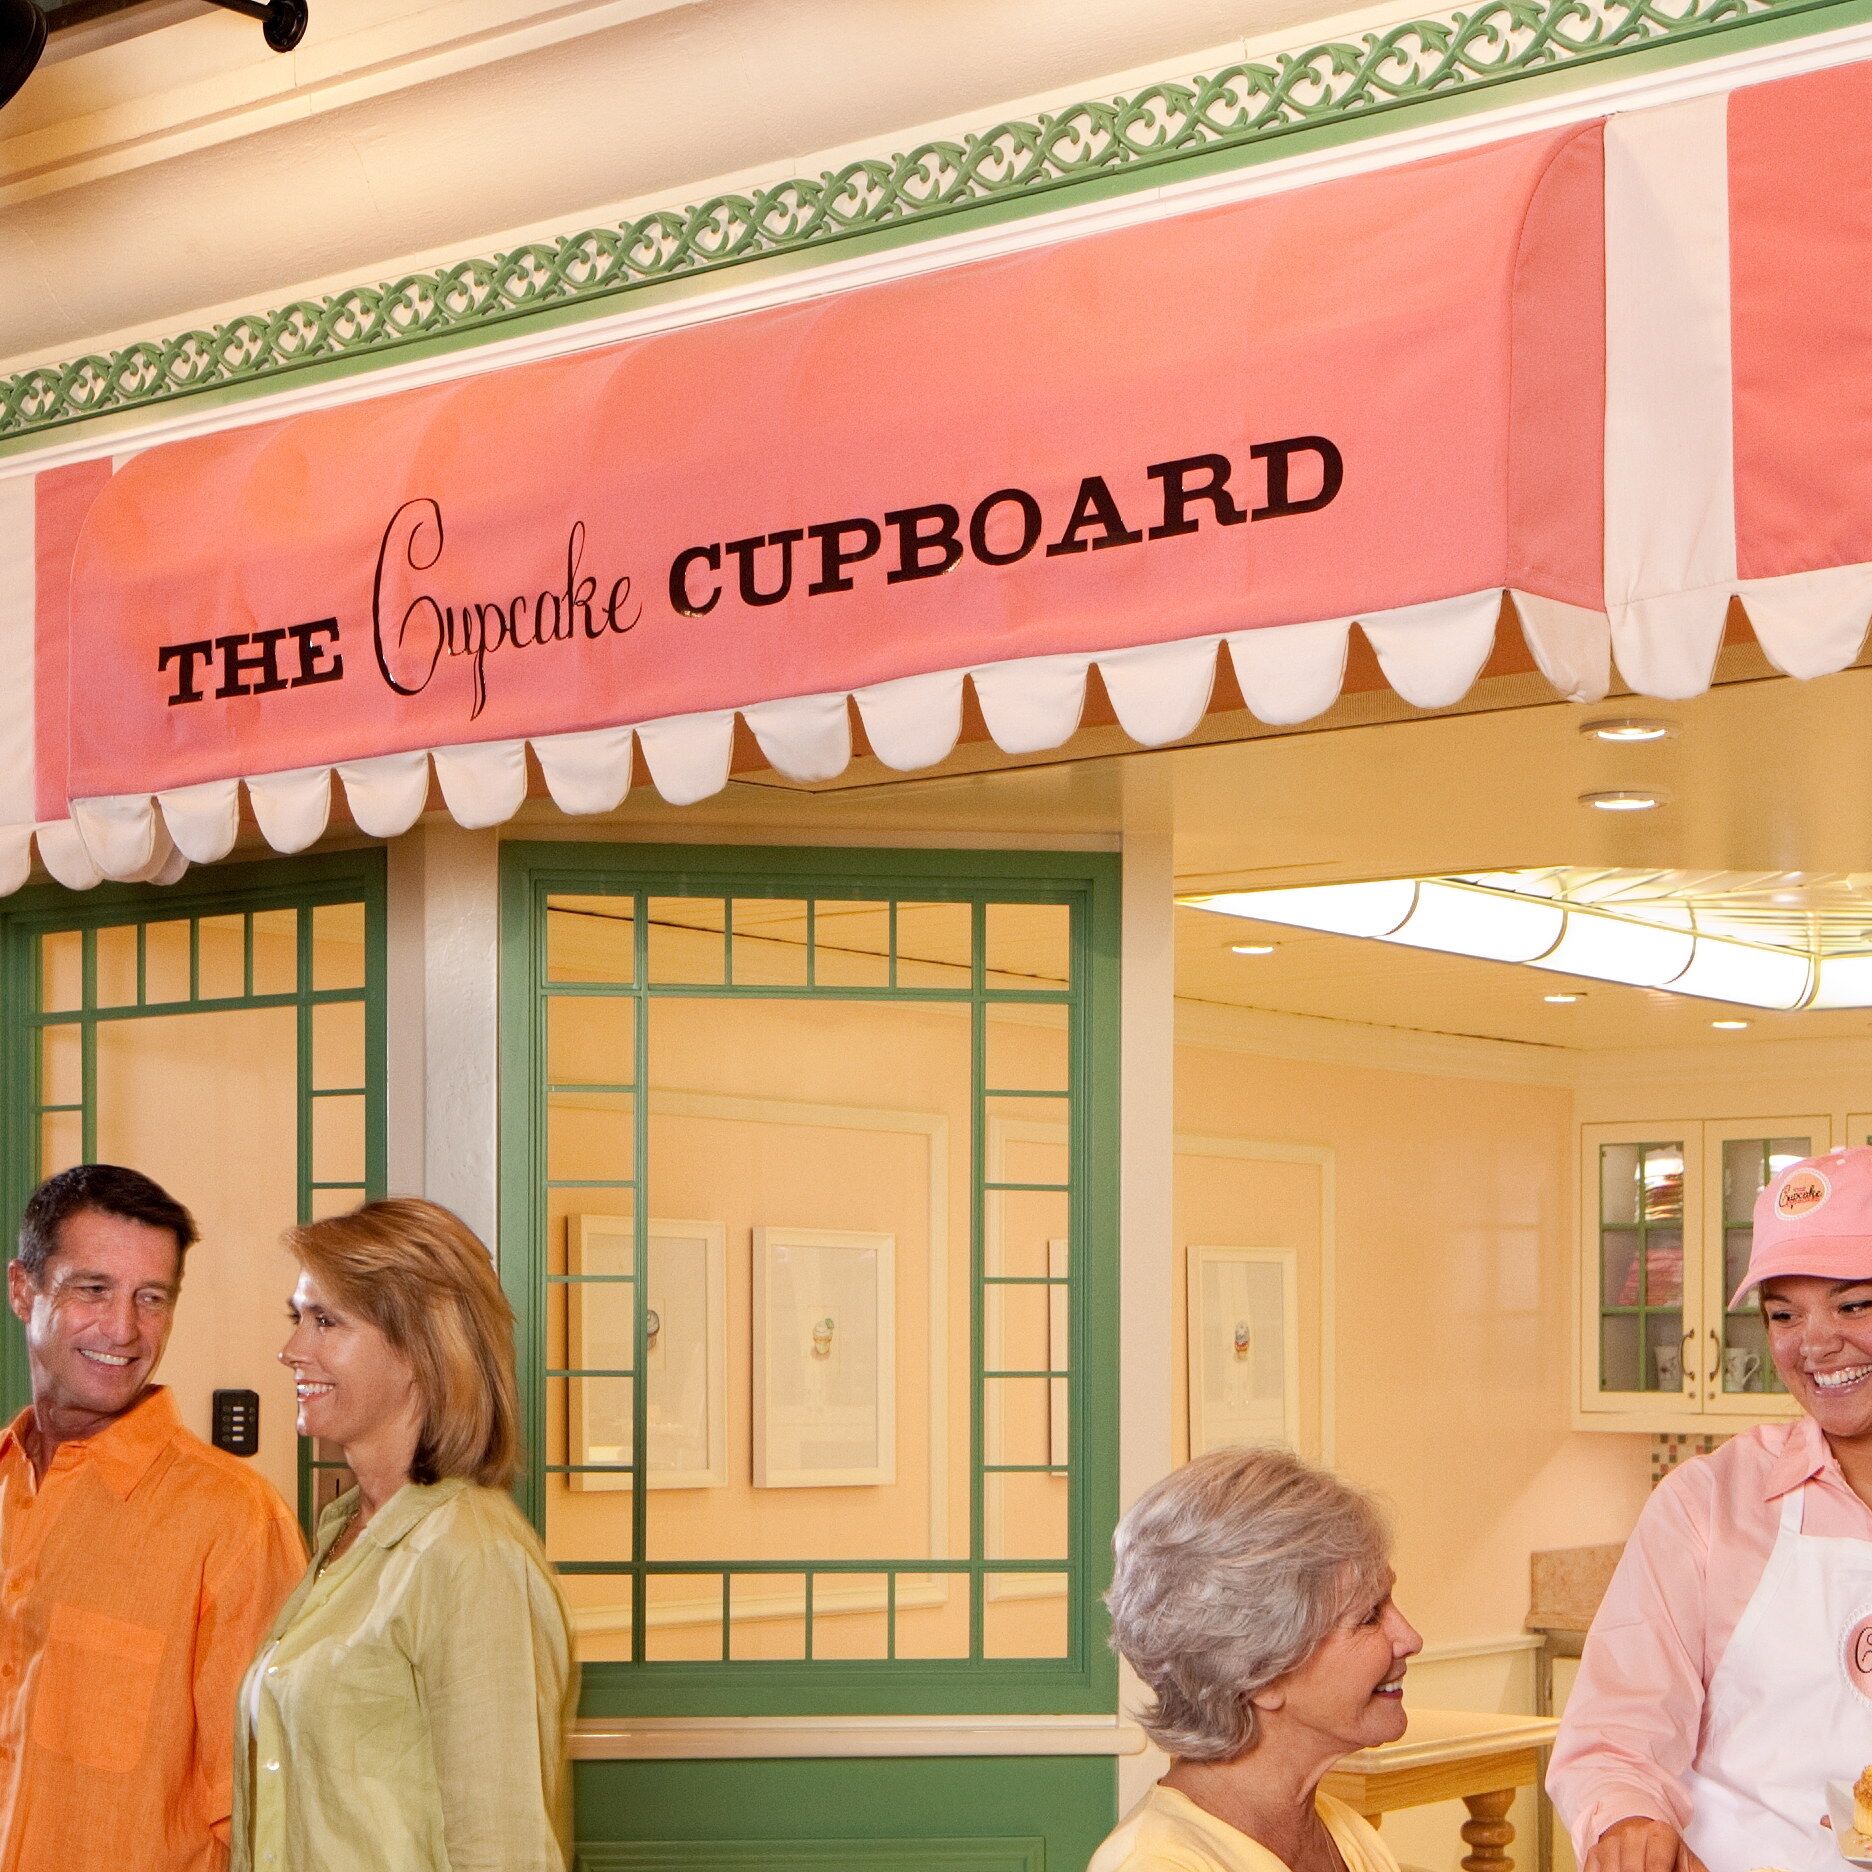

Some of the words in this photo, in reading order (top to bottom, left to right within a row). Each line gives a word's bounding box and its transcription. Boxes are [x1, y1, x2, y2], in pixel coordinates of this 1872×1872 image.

[158, 616, 343, 707] THE
[373, 497, 642, 722] Cupcake
[668, 434, 1345, 618] CUPBOARD
